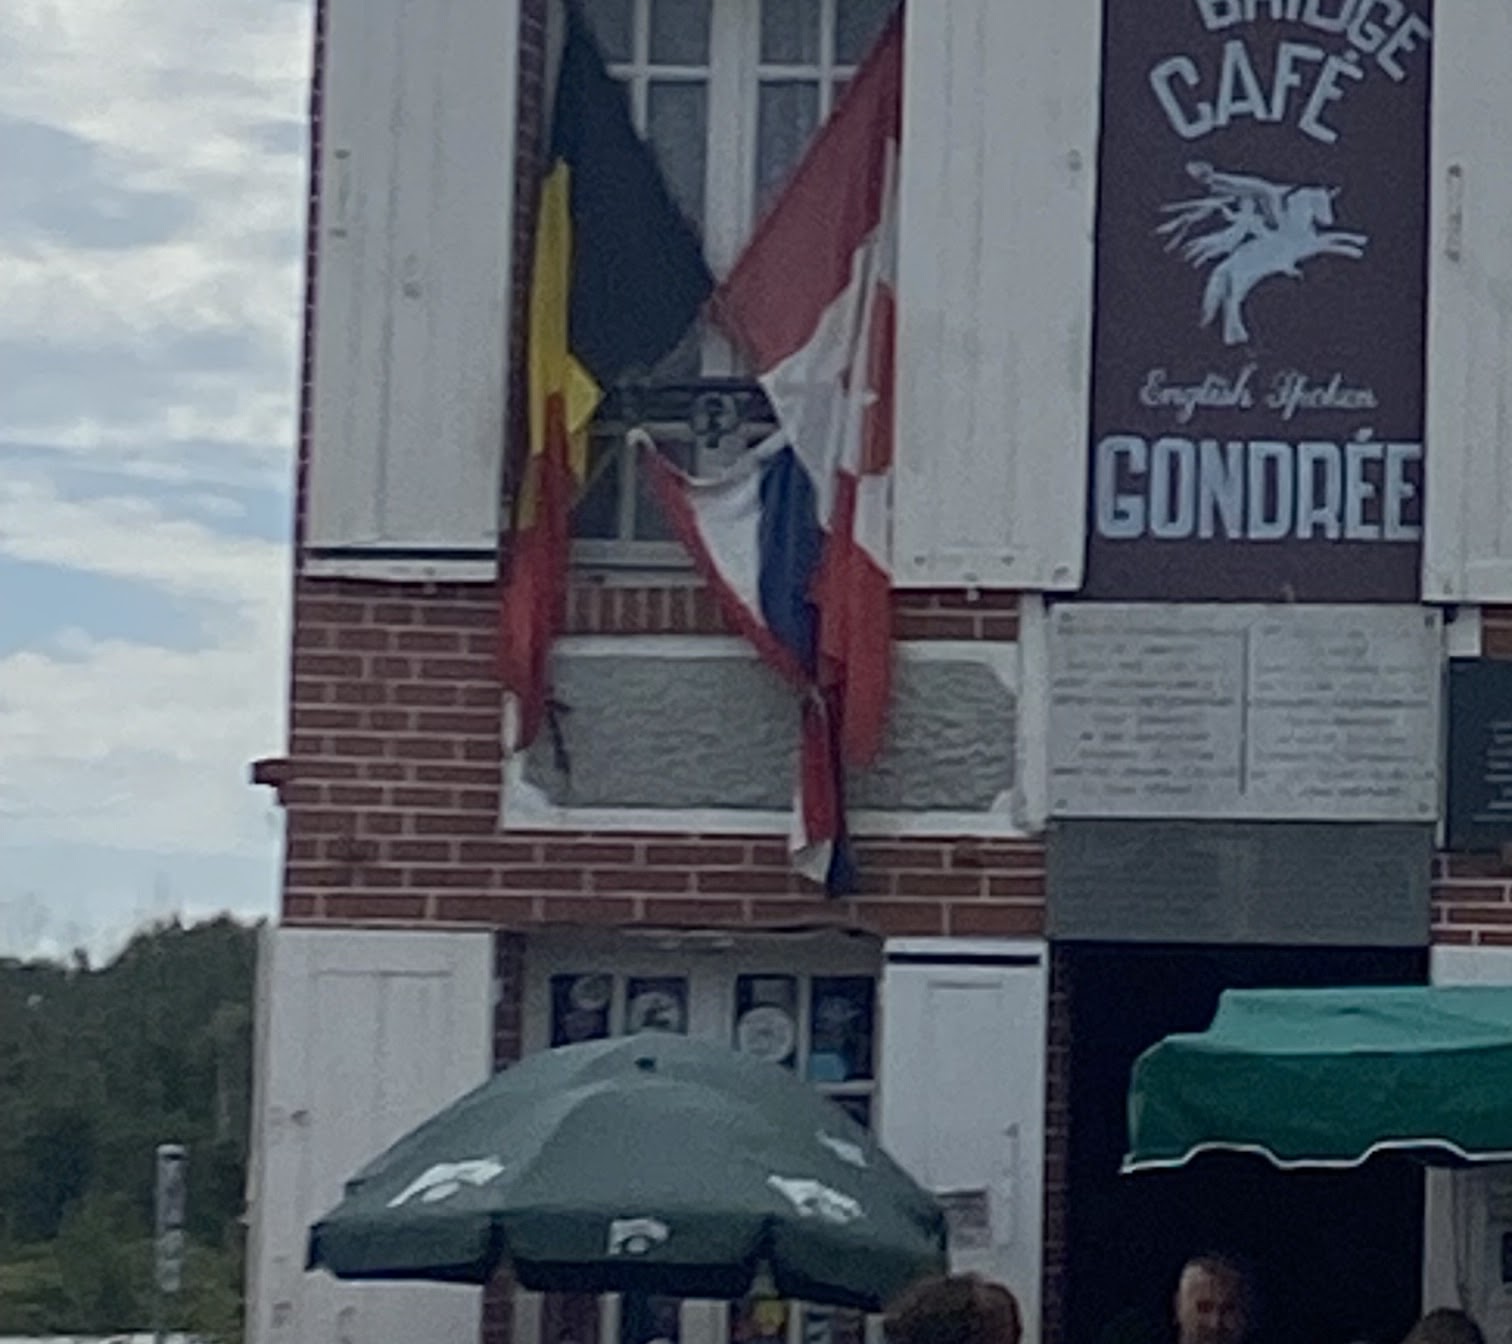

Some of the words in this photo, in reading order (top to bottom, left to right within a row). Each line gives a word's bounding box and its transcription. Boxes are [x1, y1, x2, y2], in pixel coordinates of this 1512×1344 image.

[1149, 39, 1363, 143] CAFÉ
[1139, 363, 1256, 425] English
[1264, 369, 1379, 421] Spoken
[1098, 427, 1423, 541] GONDRÉE
